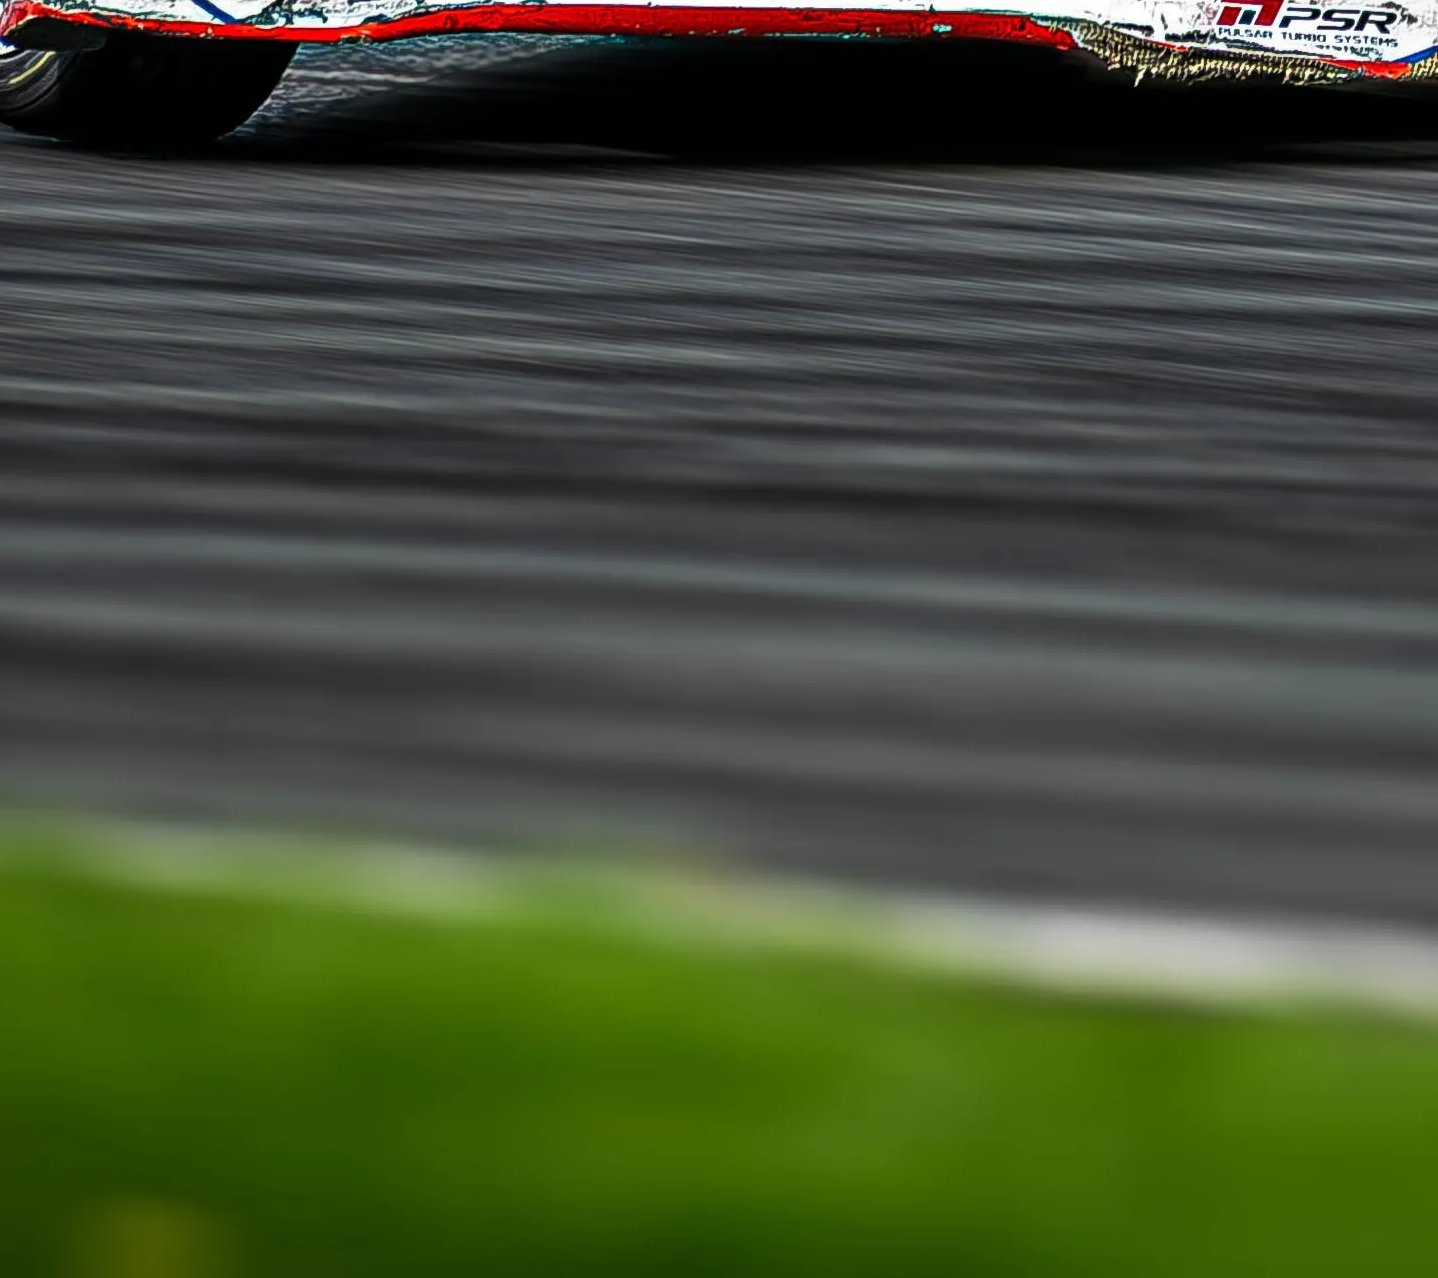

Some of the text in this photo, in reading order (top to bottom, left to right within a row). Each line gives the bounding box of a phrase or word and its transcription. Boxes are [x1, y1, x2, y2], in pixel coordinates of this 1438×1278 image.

[1279, 6, 1398, 35] PSR
[1218, 26, 1273, 40] PULSAR
[1334, 34, 1399, 48] SYSTEMS
